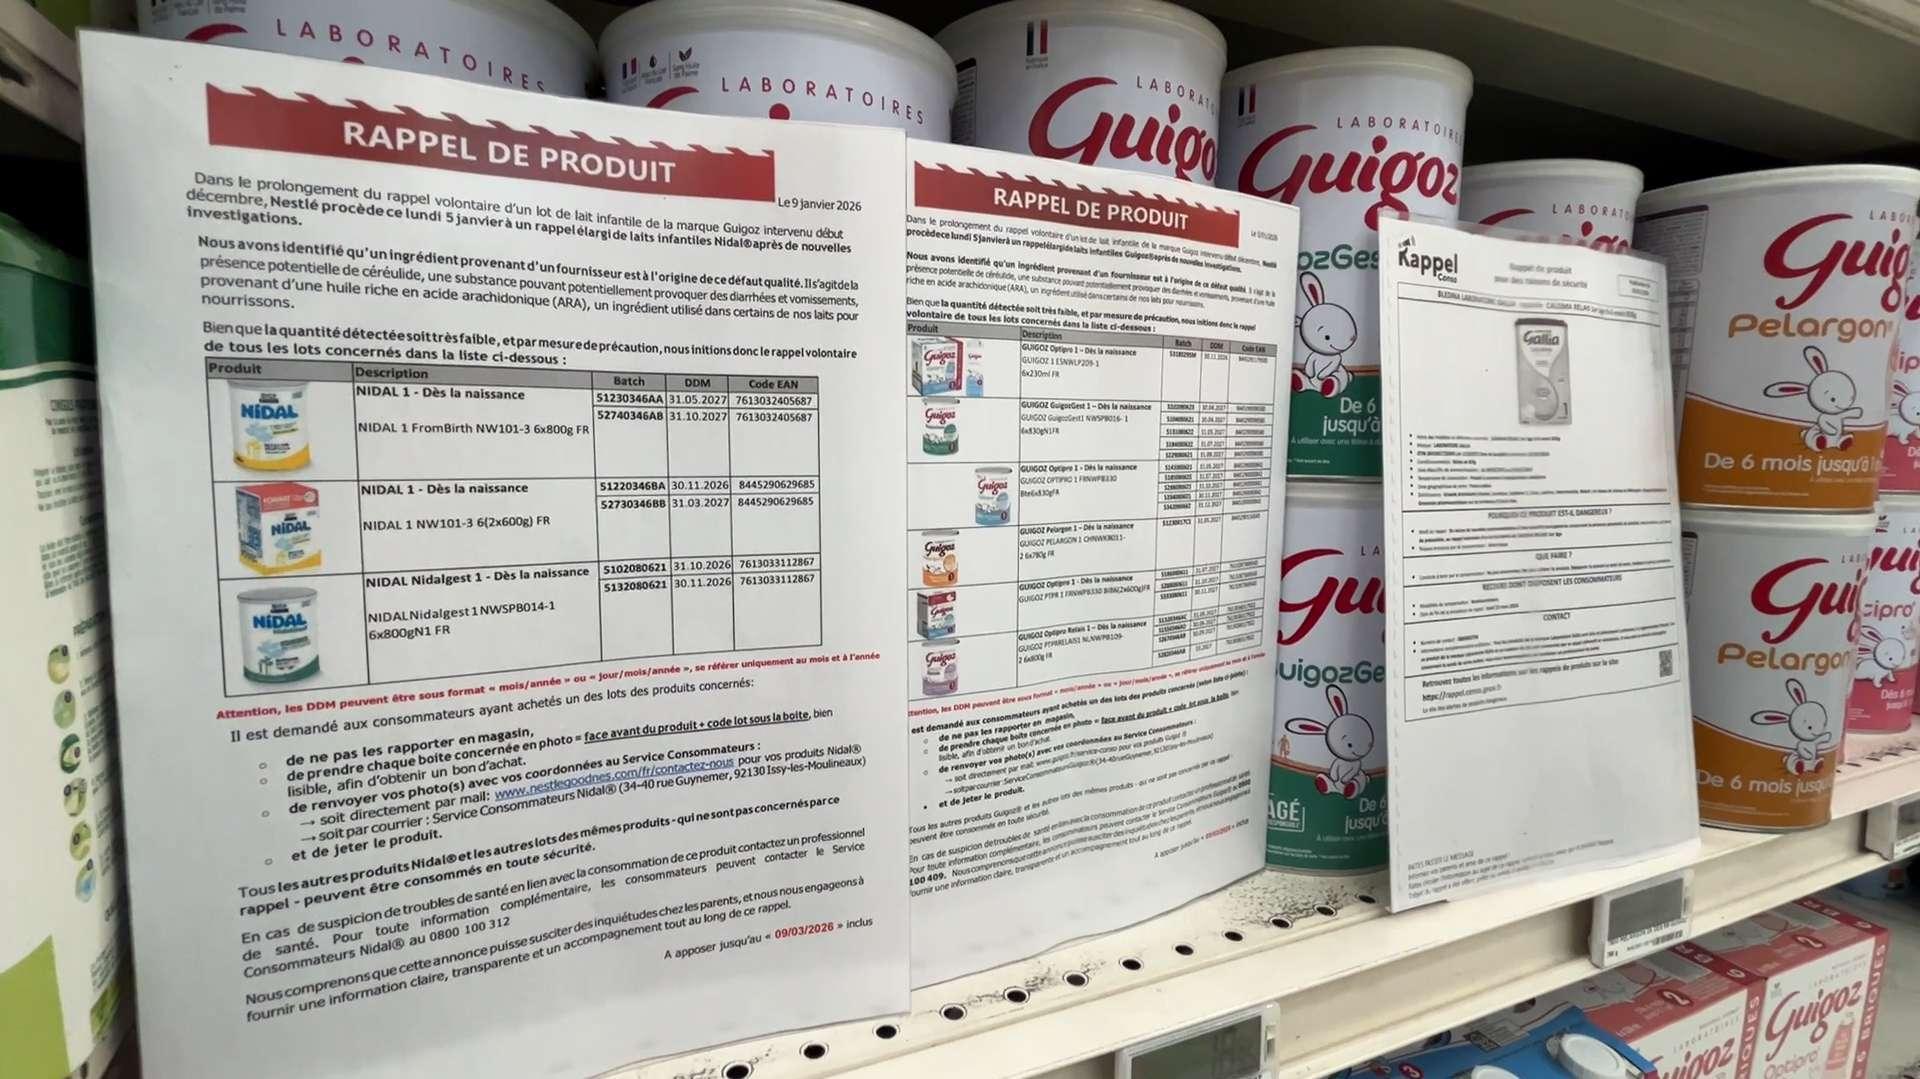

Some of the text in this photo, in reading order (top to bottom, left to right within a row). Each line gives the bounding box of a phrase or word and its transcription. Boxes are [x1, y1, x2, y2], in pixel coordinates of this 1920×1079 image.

[277, 18, 545, 92] LABORATOIRES
[721, 76, 924, 125] LABORATOIRES
[343, 120, 676, 184] RAPPEL DE PRODUIT
[1237, 123, 1460, 230] Guigoz
[778, 197, 862, 212] Le 9 janvier 2026
[993, 187, 1189, 231] RAPPEL DE PRODUIT
[186, 206, 303, 227] investigations.
[1437, 272, 1458, 284] Conso
[201, 294, 295, 309] nourrissons.
[907, 323, 1063, 342] Produit Description
[1021, 342, 1049, 353] GUIGOZ
[1084, 347, 1097, 355] Dès
[208, 363, 429, 380] Produit Description
[613, 376, 799, 390] Batch DDM Code EAN
[356, 386, 525, 400] NIDAL 1 Dès la naissance
[669, 394, 727, 405] 31.05.2027
[736, 395, 812, 406] 7613032405687
[1340, 397, 1376, 414] De 6
[669, 411, 728, 422] 31.10.2027
[736, 412, 813, 422] 7613032405687
[358, 422, 590, 436] NIDAL 1 FromBirth NW101-3 6x800g FR
[1704, 452, 1735, 470] De
[1741, 453, 1755, 471] 6
[1761, 454, 1812, 472] mois
[361, 483, 528, 495] NIDAL 1 Dès la naissance
[671, 480, 729, 490] 30.11.2026
[739, 480, 815, 490] 8445290629685
[672, 497, 730, 508] 31.03.2027
[738, 496, 814, 507] 8445290629685
[1020, 527, 1046, 537] GUIGOZ
[674, 560, 732, 571] 31.10.2026
[740, 557, 815, 569] 7613033112867
[366, 567, 590, 588] NIDAL Nidalgest 1 Dès la naissance
[674, 577, 732, 588] 30.11.2026
[740, 573, 815, 585] 7613033112867
[369, 625, 450, 640] 6x800gN1 FR
[1696, 769, 1724, 788] De
[1730, 775, 1743, 790] 6
[1749, 778, 1793, 794] mois
[939, 800, 948, 808] et
[950, 798, 961, 806] de
[962, 795, 982, 805] jeter
[994, 786, 1025, 799] produit.
[927, 872, 947, 882] 409.
[775, 917, 873, 939] 09/03/2026 inclus
[242, 945, 356, 978] Consommateurs
[409, 935, 426, 946] au
[429, 926, 460, 942] 0800
[465, 921, 486, 934] 100
[489, 916, 510, 929] 312
[675, 943, 716, 959] apposer
[1861, 944, 1886, 1040] BRIQUES
[1765, 980, 1862, 1062] Guigoz
